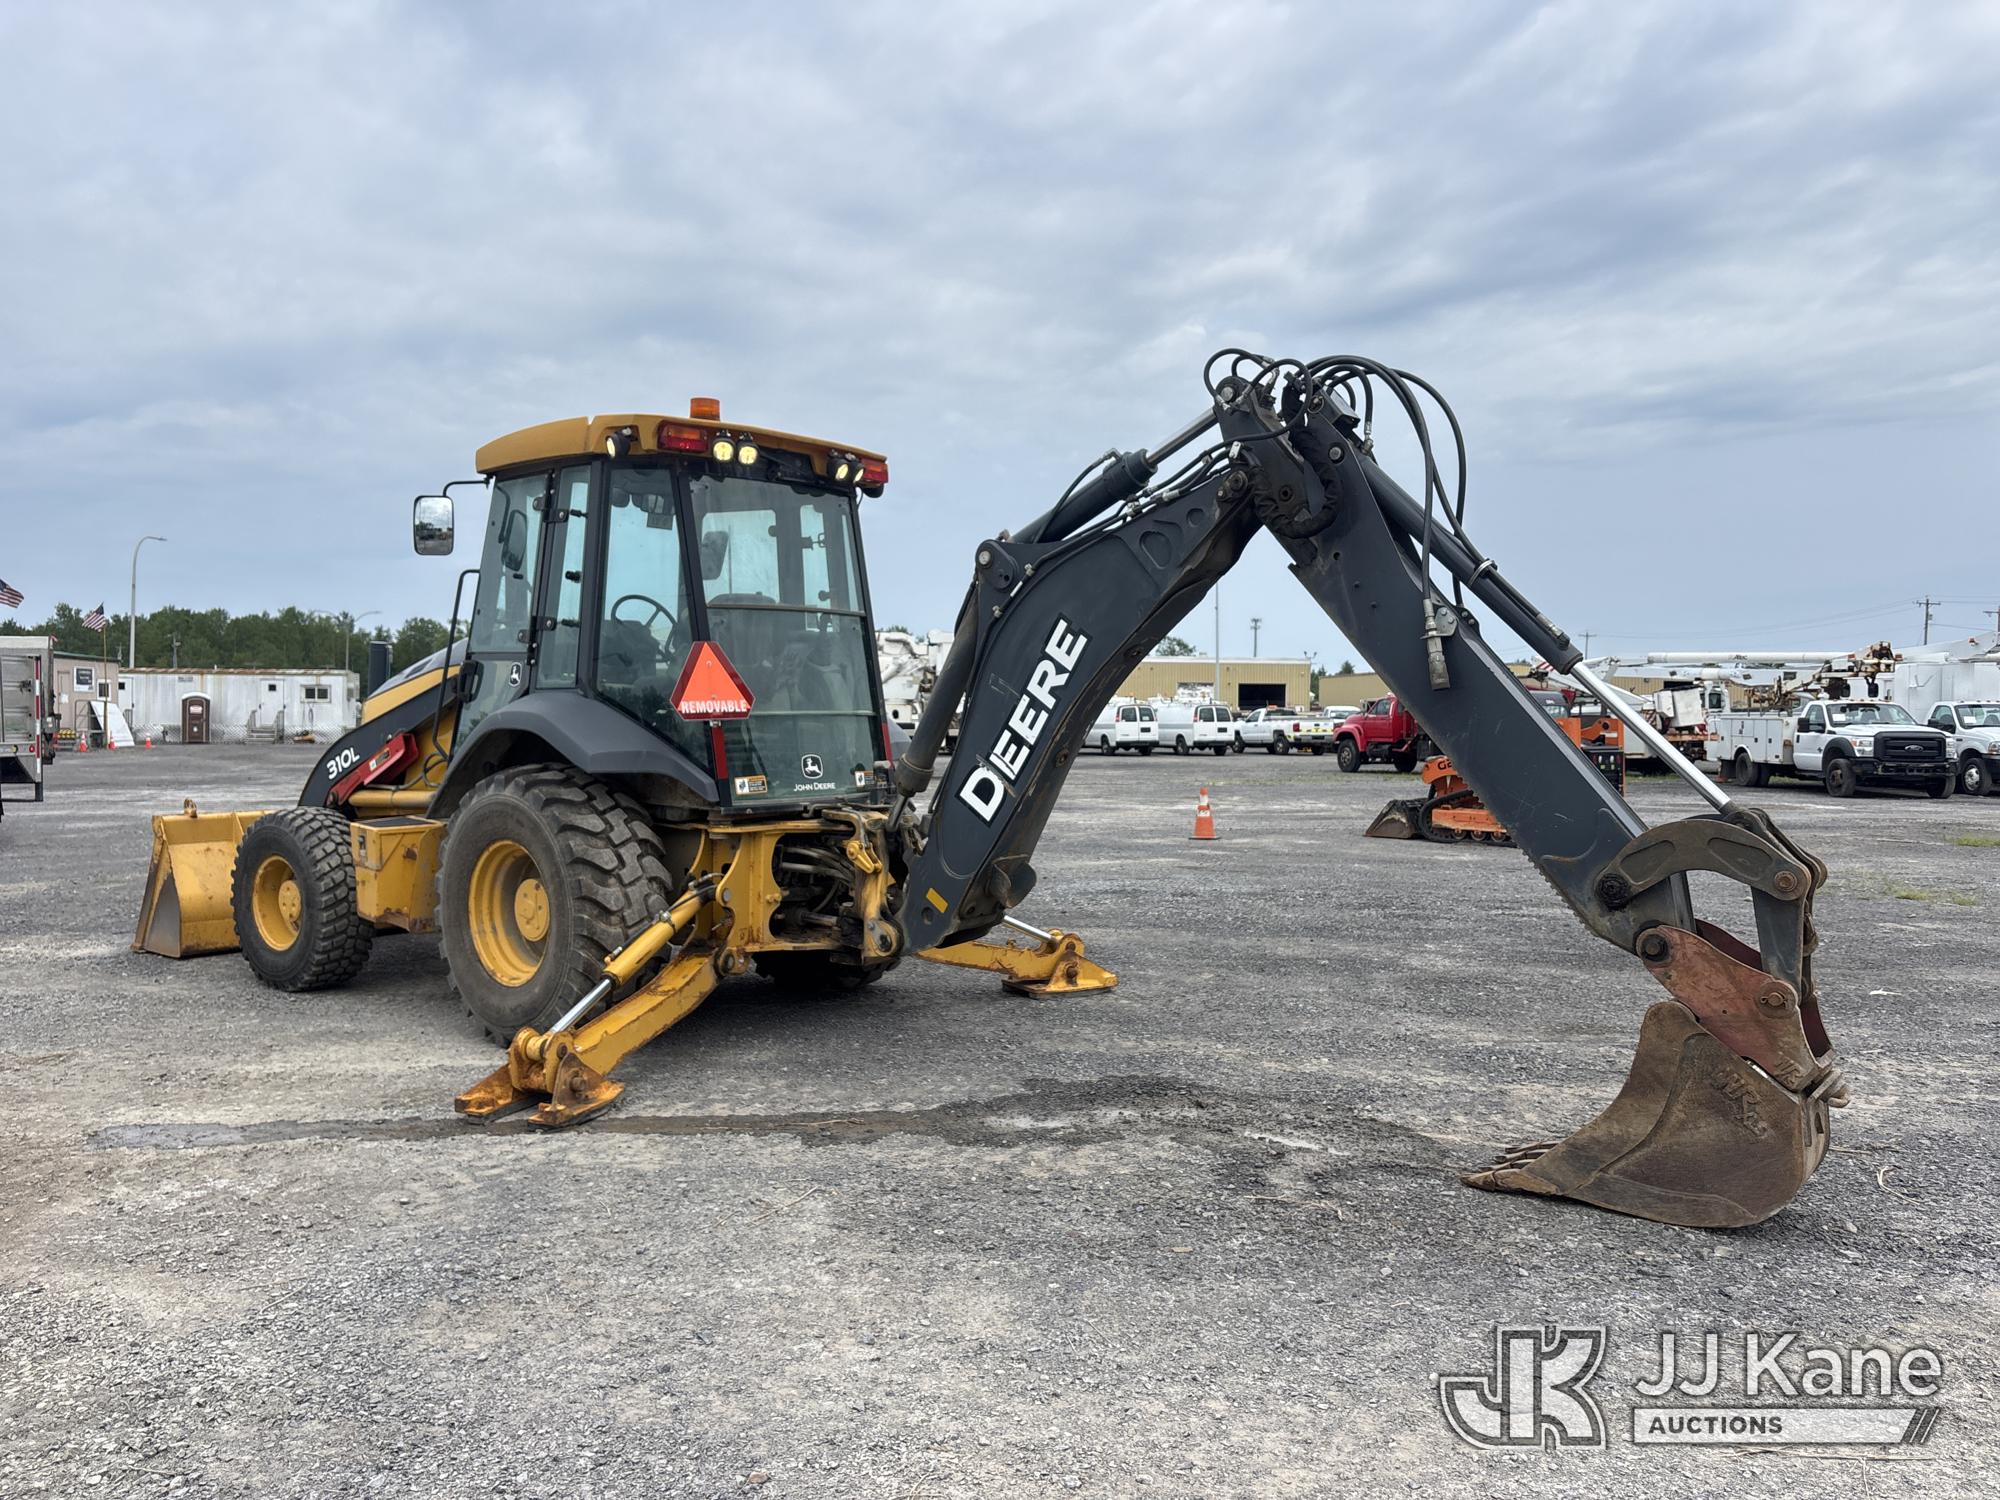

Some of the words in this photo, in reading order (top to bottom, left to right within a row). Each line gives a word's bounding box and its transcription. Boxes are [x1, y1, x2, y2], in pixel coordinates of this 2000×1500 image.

[680, 699, 748, 714] REMOVABLE
[959, 618, 1088, 822] DEERE
[326, 747, 360, 780] 310L
[793, 783, 814, 792] JOHN
[814, 782, 836, 791] DEERE
